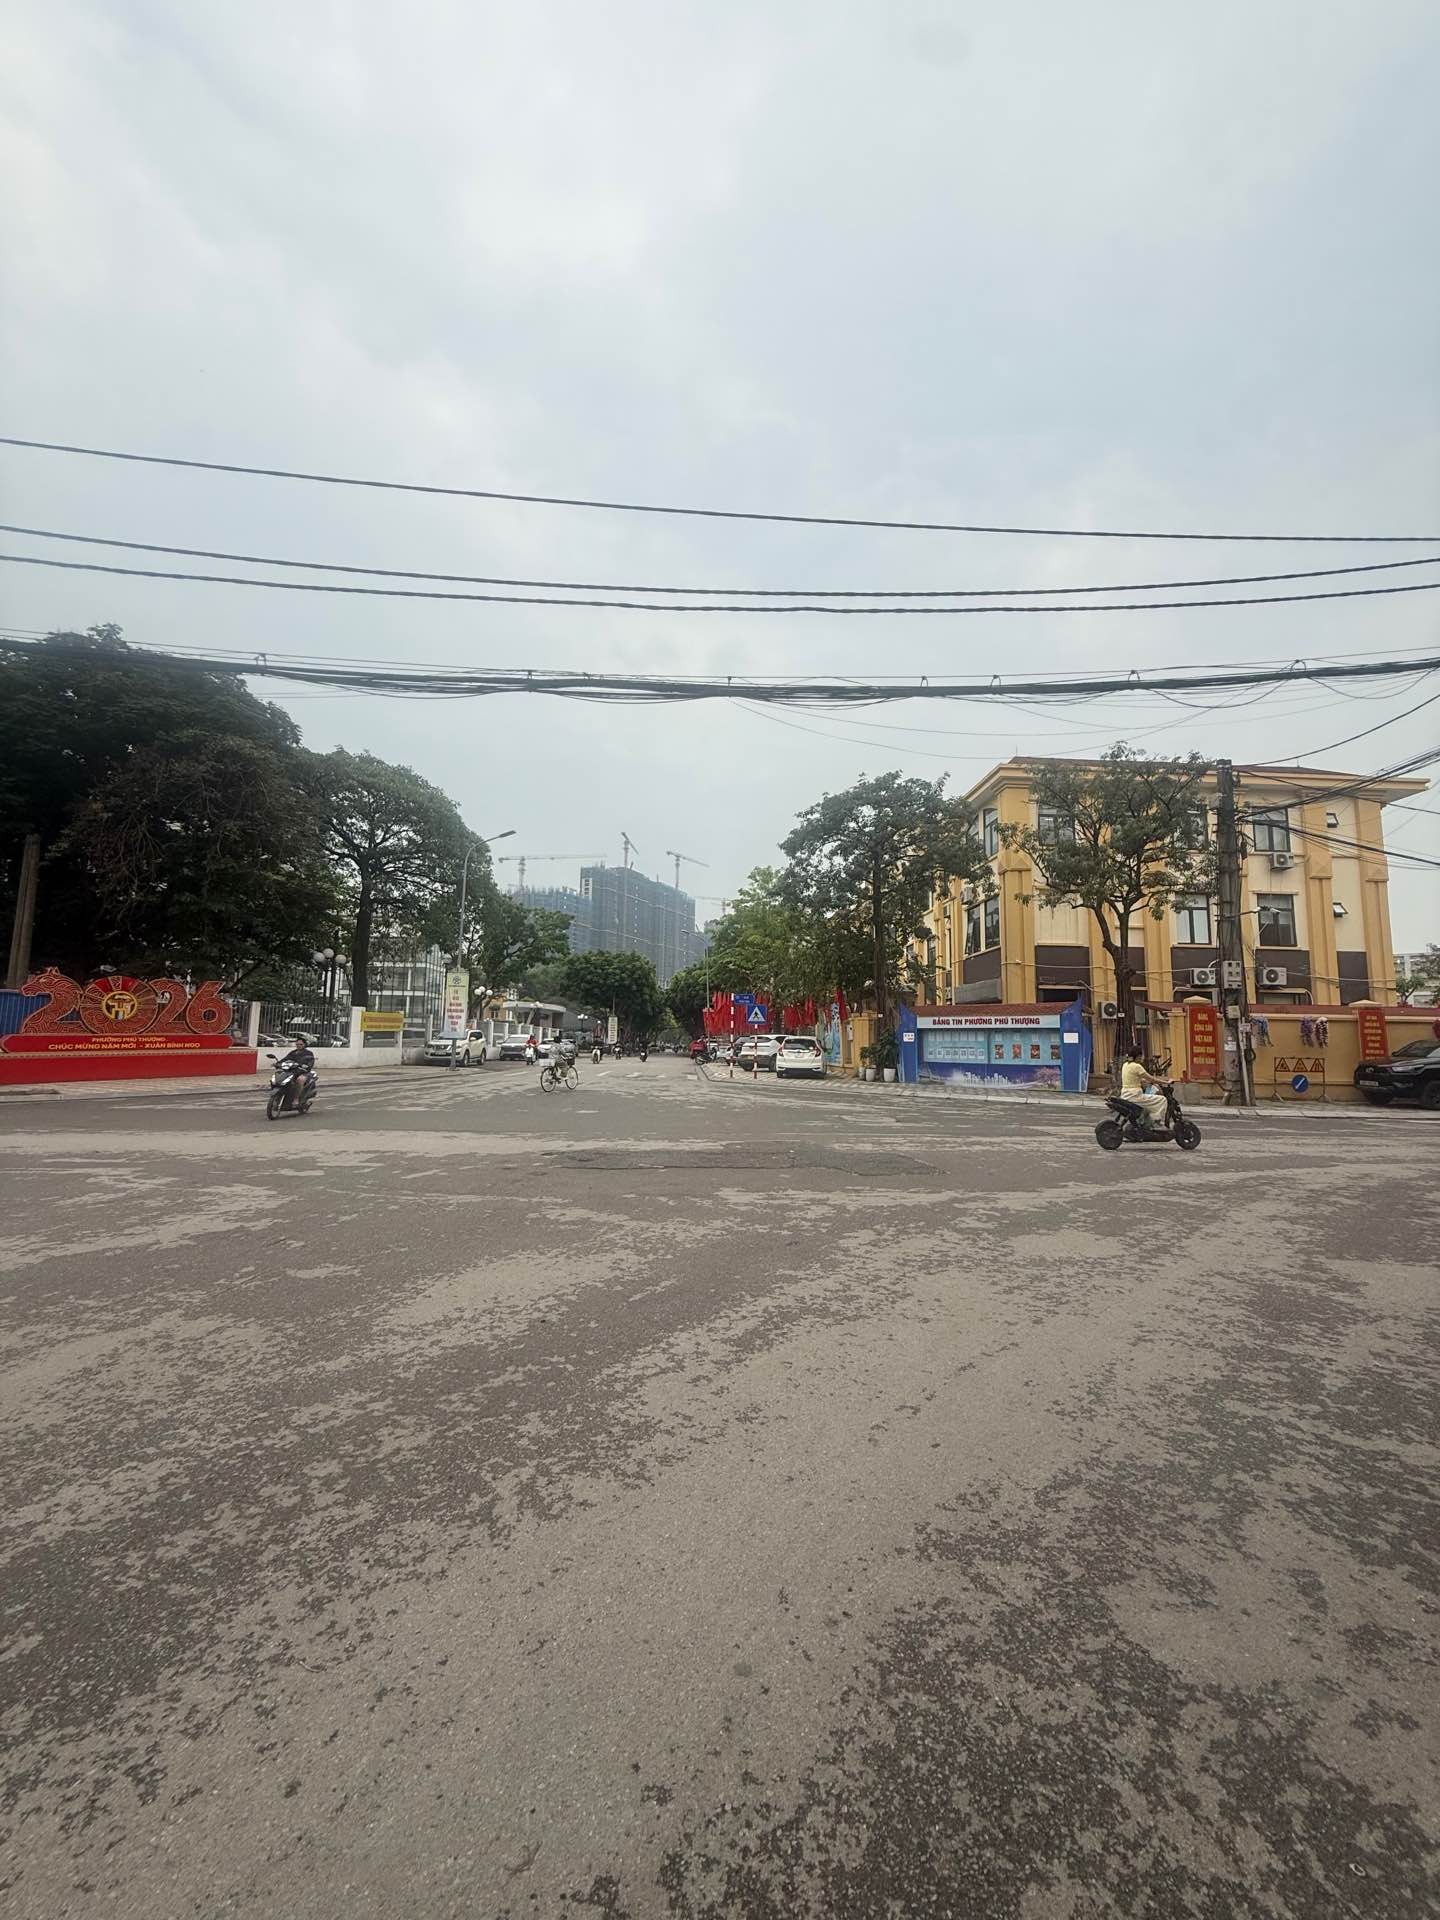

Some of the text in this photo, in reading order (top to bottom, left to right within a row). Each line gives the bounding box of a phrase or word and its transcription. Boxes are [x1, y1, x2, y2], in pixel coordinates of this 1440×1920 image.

[21, 967, 232, 1034] 2026
[932, 1016, 951, 1025] BẢNG
[964, 1017, 993, 1025] PHƯỜNG
[994, 1017, 1009, 1025] PHÚ
[1011, 1017, 1040, 1026] THƯỢNG
[48, 1042, 74, 1050] CHÚC
[74, 1042, 101, 1050] MỪNG
[121, 1041, 137, 1049] MỚI
[144, 1041, 166, 1049] XUÂN
